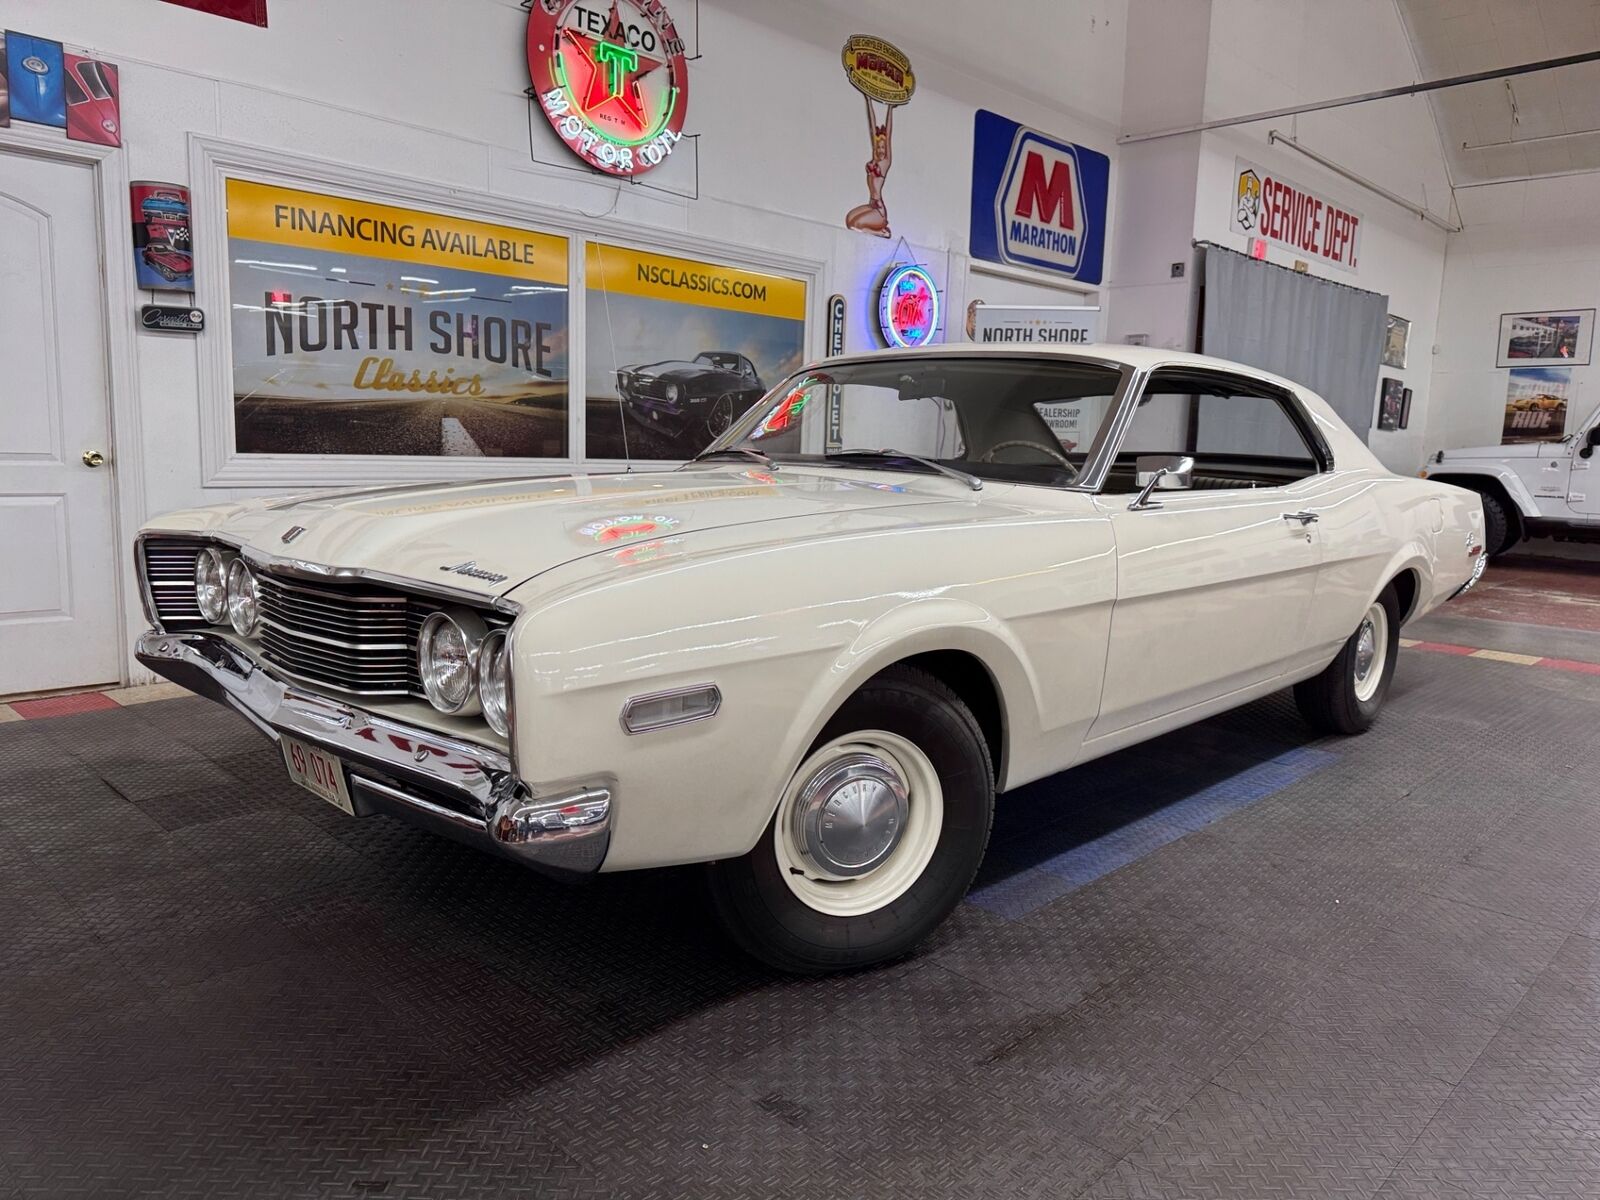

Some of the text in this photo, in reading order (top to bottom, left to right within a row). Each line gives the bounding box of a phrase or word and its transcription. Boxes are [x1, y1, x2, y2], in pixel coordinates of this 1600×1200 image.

[574, 6, 656, 52] TEXACO
[542, 87, 634, 172] MOTOR
[637, 128, 682, 165] OIL
[274, 204, 534, 265] FINANCING AVAILABLE
[1009, 220, 1076, 256] MARATHON
[1260, 176, 1359, 268] SERVICE DEPT.
[637, 263, 767, 302] NSCLASSICS.COM
[264, 291, 552, 378] NORTH SHORE
[983, 328, 1033, 343] NORTH
[353, 356, 486, 397] Classics
[1036, 407, 1081, 418] EALERSHIP
[1511, 411, 1552, 429] RIDE
[290, 742, 307, 777] 69
[309, 752, 340, 794] 074
